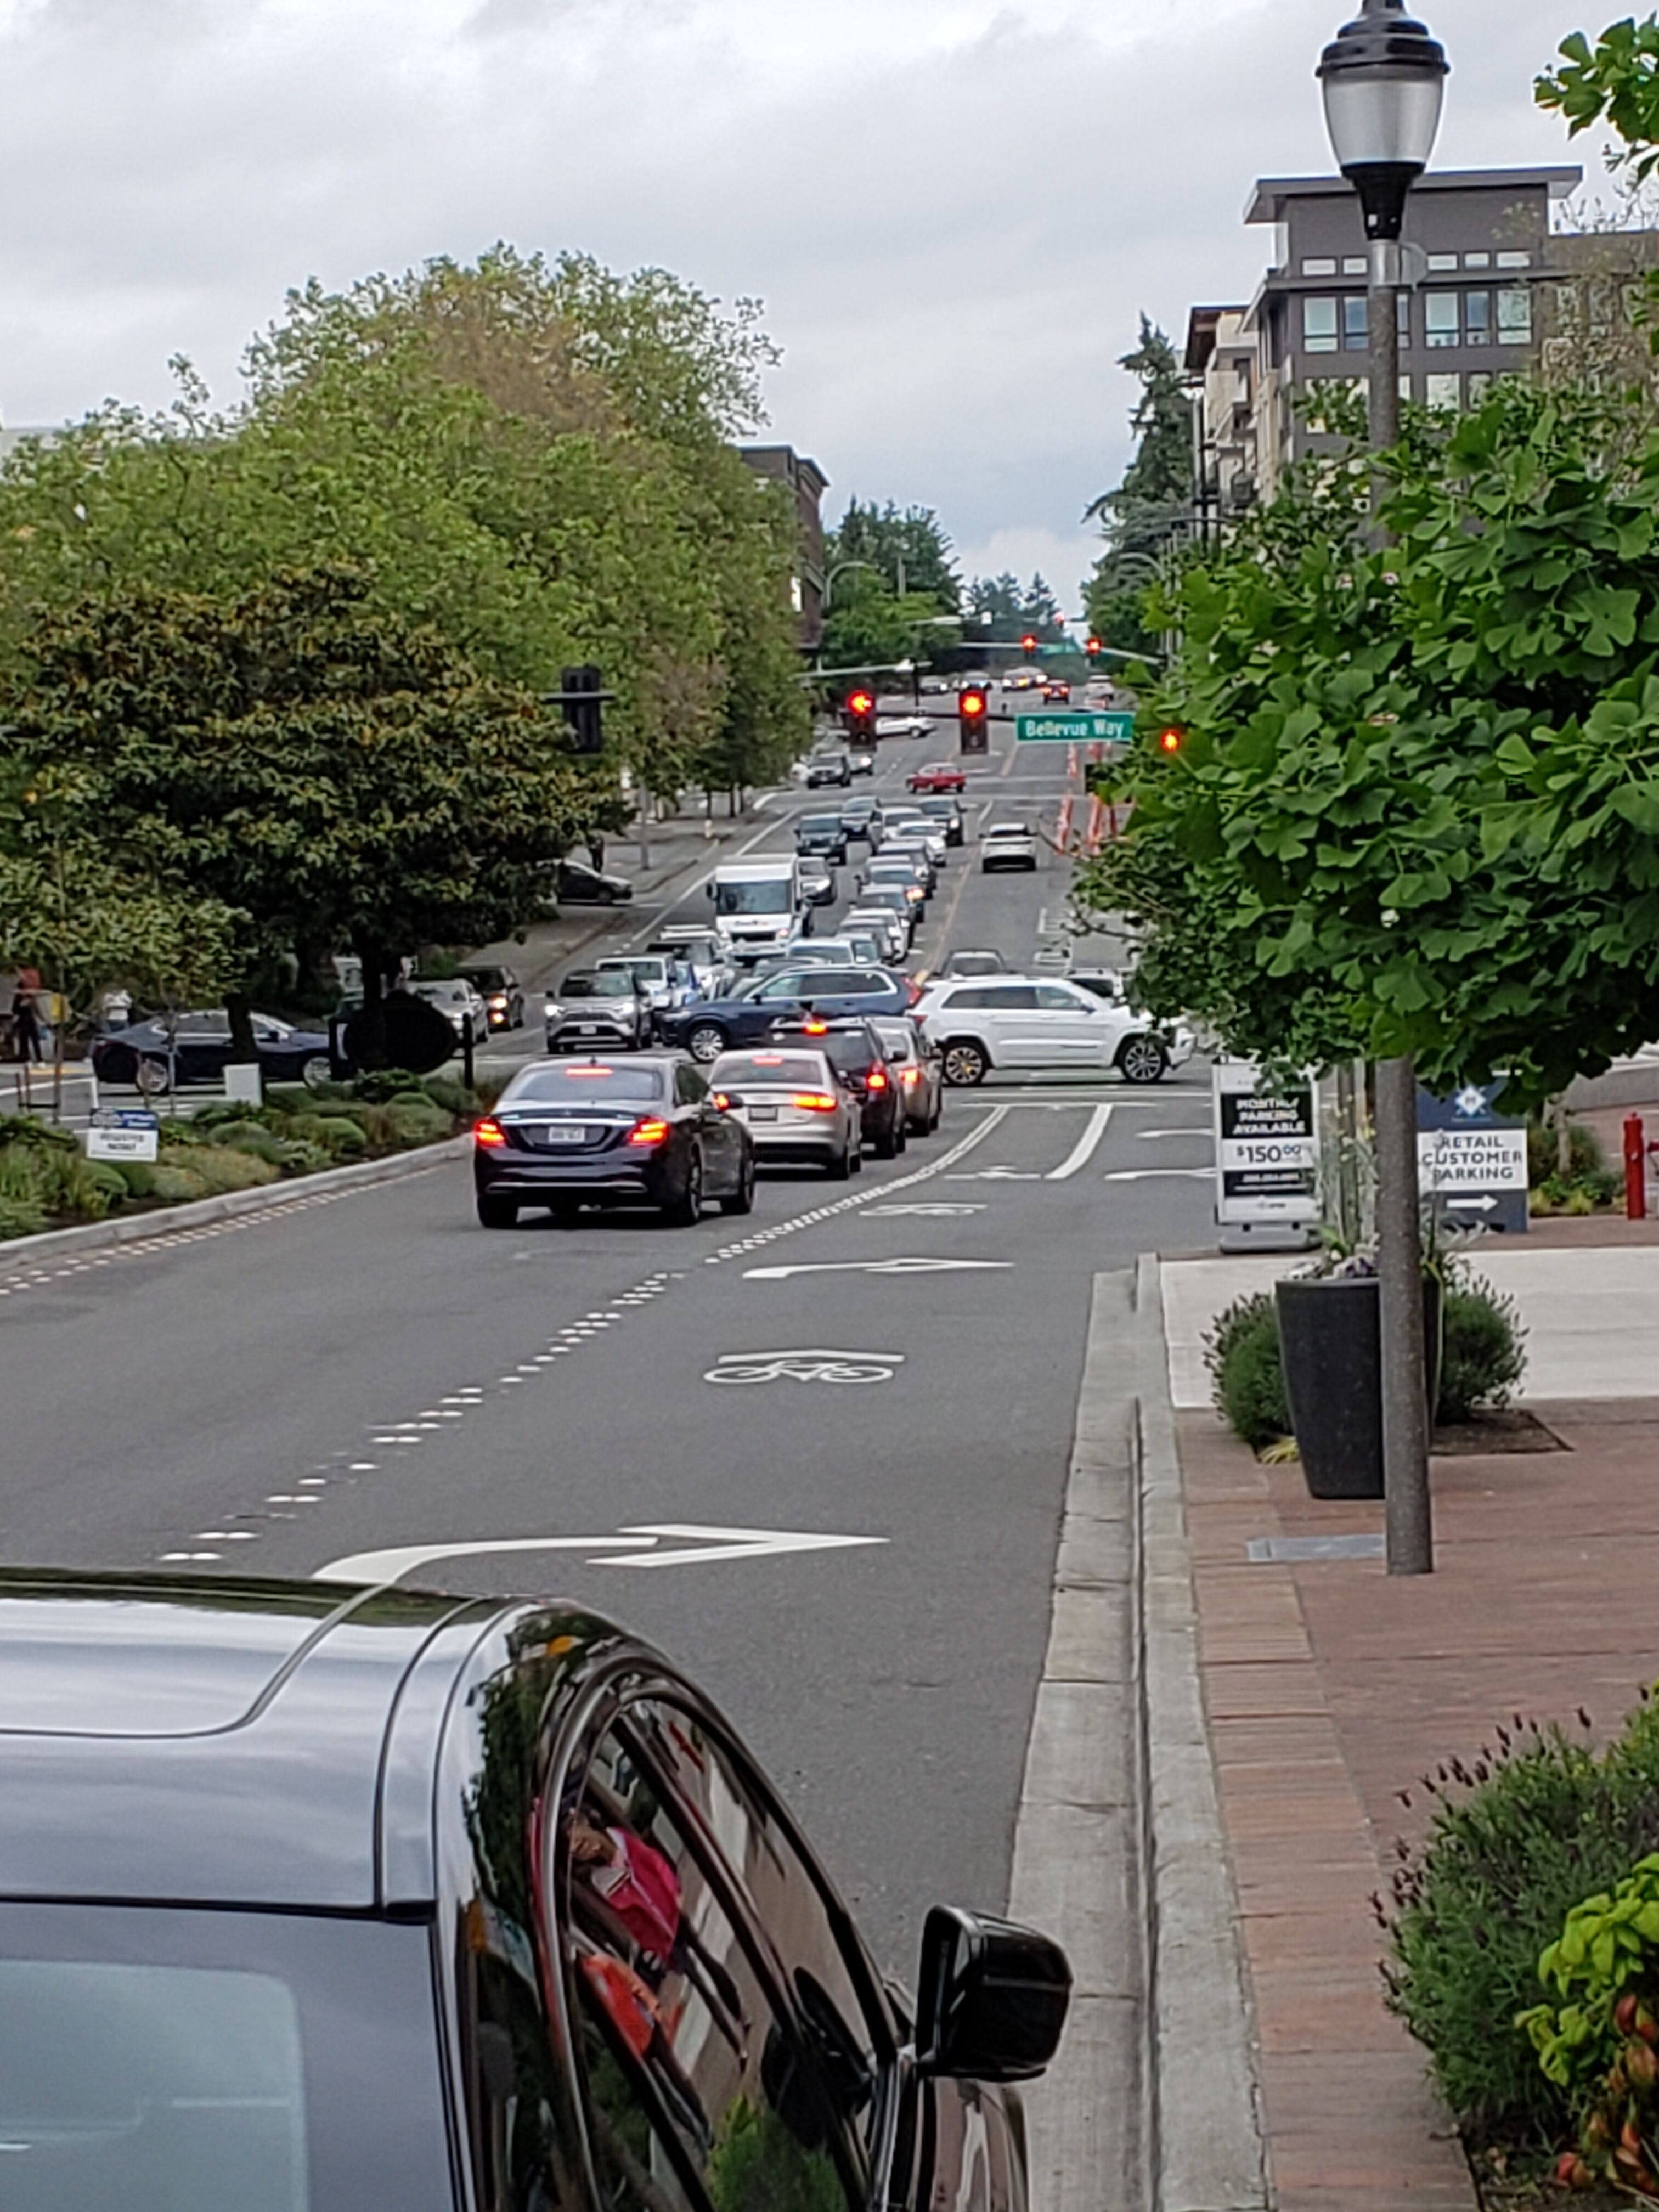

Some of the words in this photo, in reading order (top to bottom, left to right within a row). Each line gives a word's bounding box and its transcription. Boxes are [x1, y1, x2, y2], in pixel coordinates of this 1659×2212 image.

[1025, 720, 1088, 737] Bellevue
[1093, 719, 1124, 739] Way
[1239, 1110, 1299, 1122] PARKING
[1232, 1120, 1306, 1135] AVAILABLE
[1438, 1136, 1504, 1149] RETAIL
[1421, 1150, 1523, 1166] CUSTOMER
[1434, 1166, 1513, 1181] PARKING
